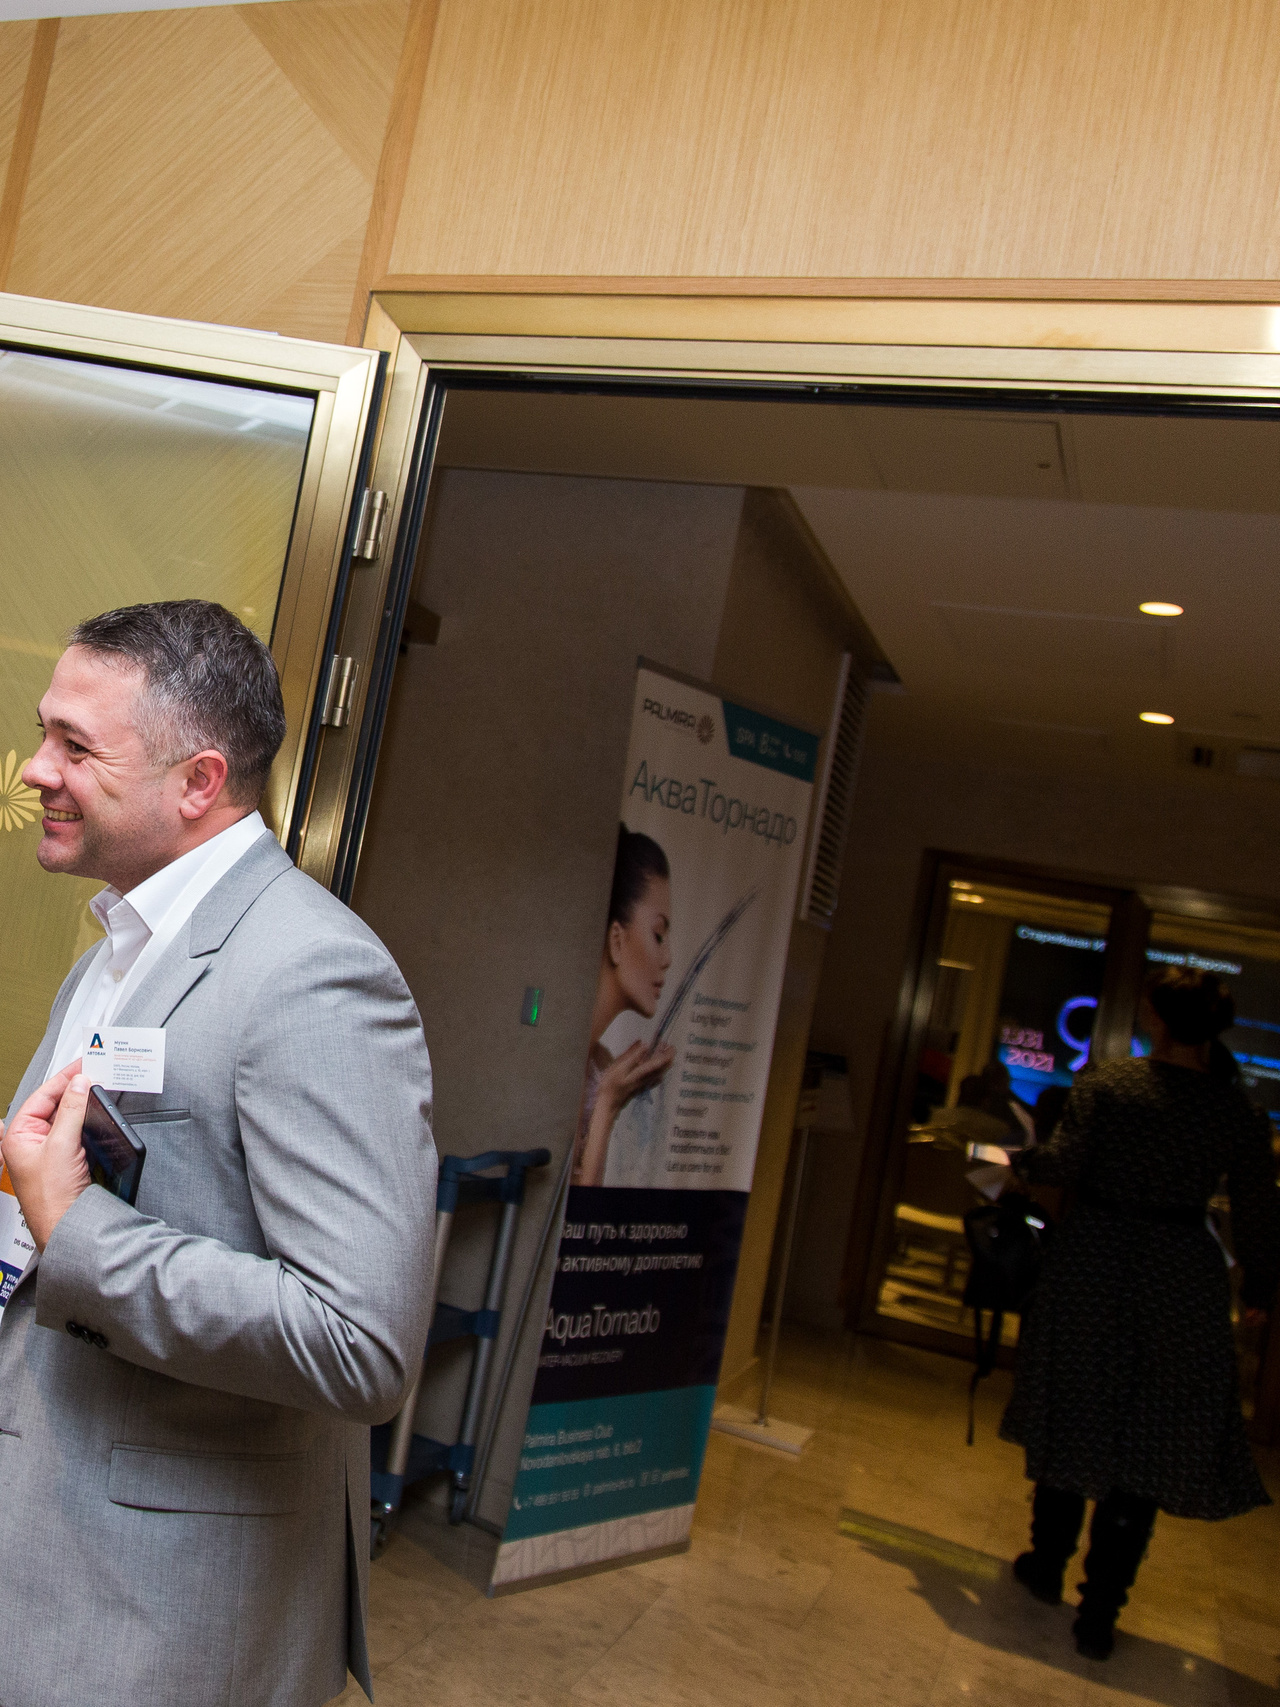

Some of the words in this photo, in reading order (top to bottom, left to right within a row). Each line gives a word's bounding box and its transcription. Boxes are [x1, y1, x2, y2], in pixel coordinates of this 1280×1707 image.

[643, 697, 697, 730] PALMIRA
[629, 759, 798, 848] АкваТорнадо
[1005, 1046, 1056, 1073] 2021
[21, 1241, 35, 1252] GROUP
[588, 1223, 617, 1245] путь
[618, 1223, 628, 1239] к
[628, 1223, 689, 1244] здоровью
[562, 1254, 633, 1277] активному
[634, 1252, 704, 1275] долголетию
[546, 1303, 661, 1347] AquaTornado
[557, 1429, 594, 1446] Business
[594, 1423, 614, 1440] Club
